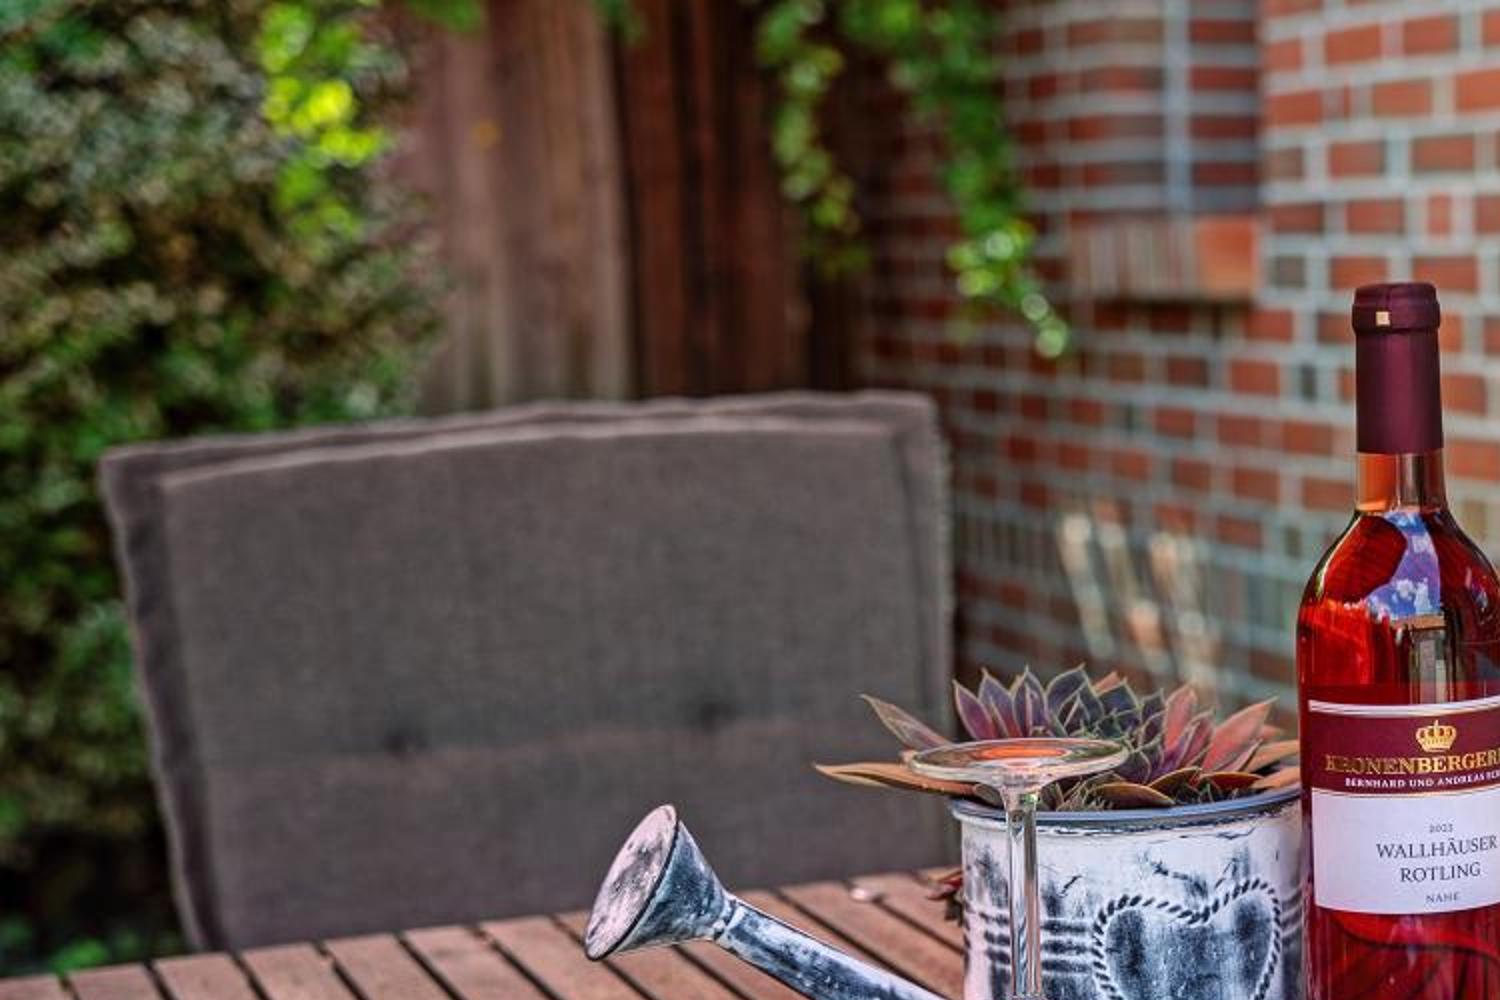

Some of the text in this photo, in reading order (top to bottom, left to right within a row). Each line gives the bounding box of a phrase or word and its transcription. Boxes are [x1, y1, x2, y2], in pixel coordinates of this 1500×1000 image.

[1345, 777, 1405, 788] BERNHARD
[1409, 778, 1435, 788] UND
[1439, 772, 1485, 787] ANDREAS
[1376, 835, 1498, 859] WALLHÄUSER
[1400, 862, 1481, 882] ROTLING
